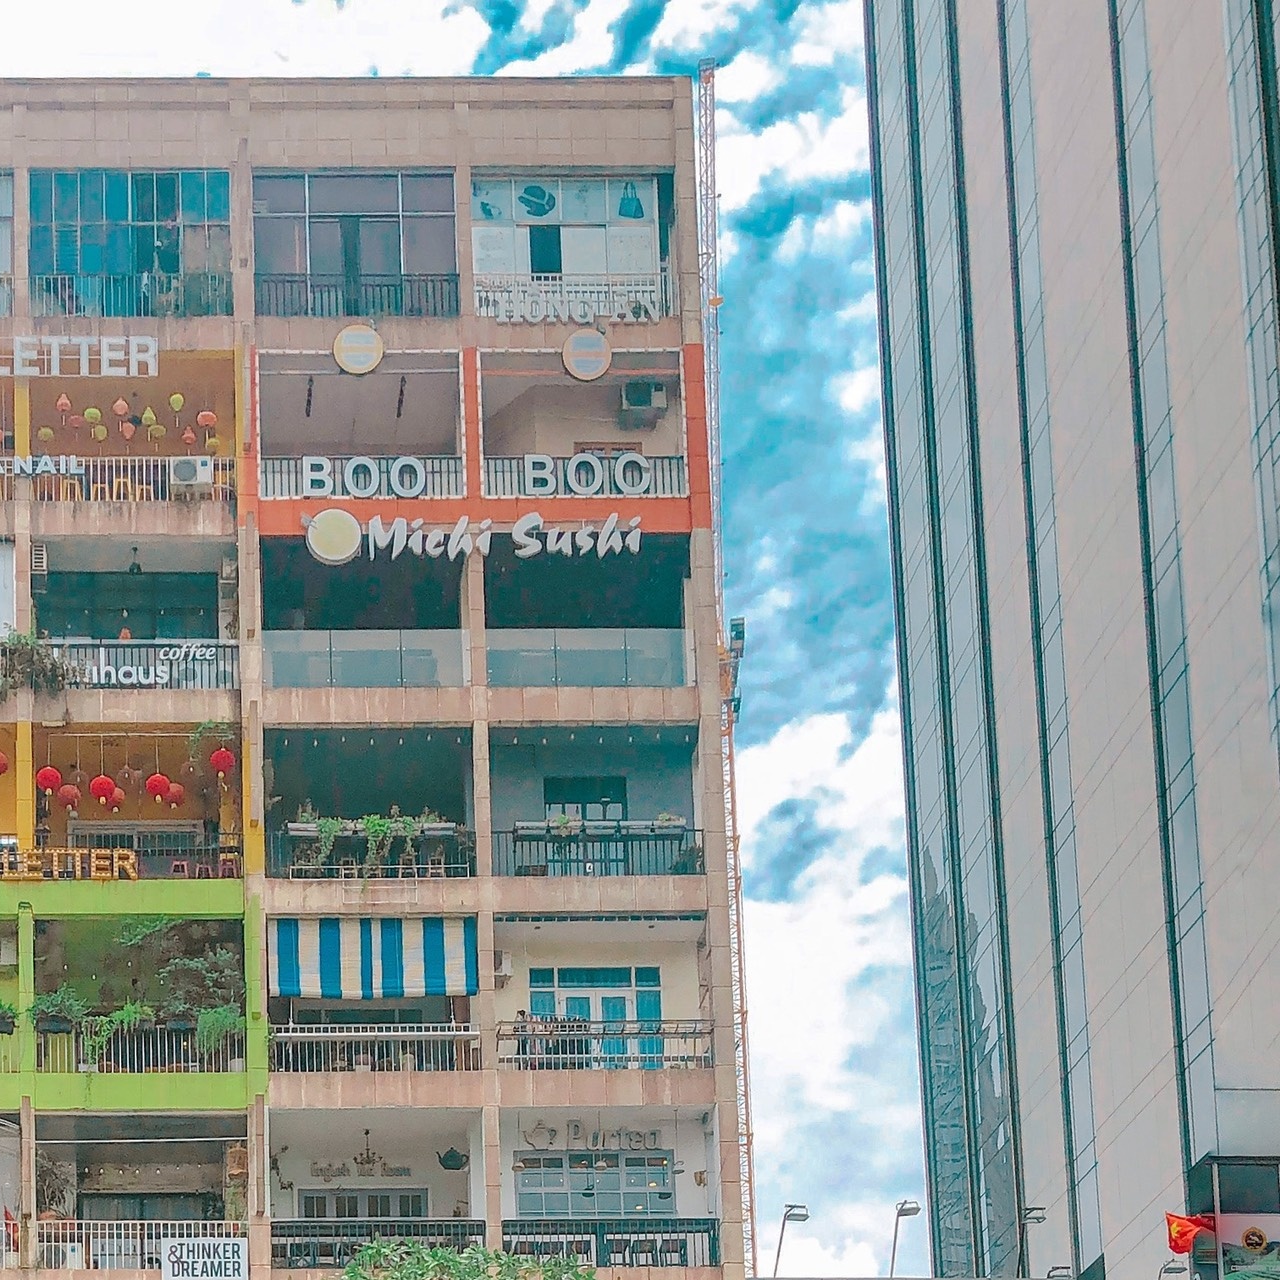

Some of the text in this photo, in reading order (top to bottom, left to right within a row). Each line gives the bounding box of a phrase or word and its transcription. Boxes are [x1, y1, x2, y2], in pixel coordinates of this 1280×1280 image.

[14, 455, 85, 475] NAIL
[302, 456, 425, 498] BOO
[368, 511, 642, 561] Michi Sushi
[159, 644, 217, 662] coffee
[3, 847, 139, 881] LETTER
[177, 1243, 241, 1259] THINKER
[172, 1261, 241, 1277] DREAMER
